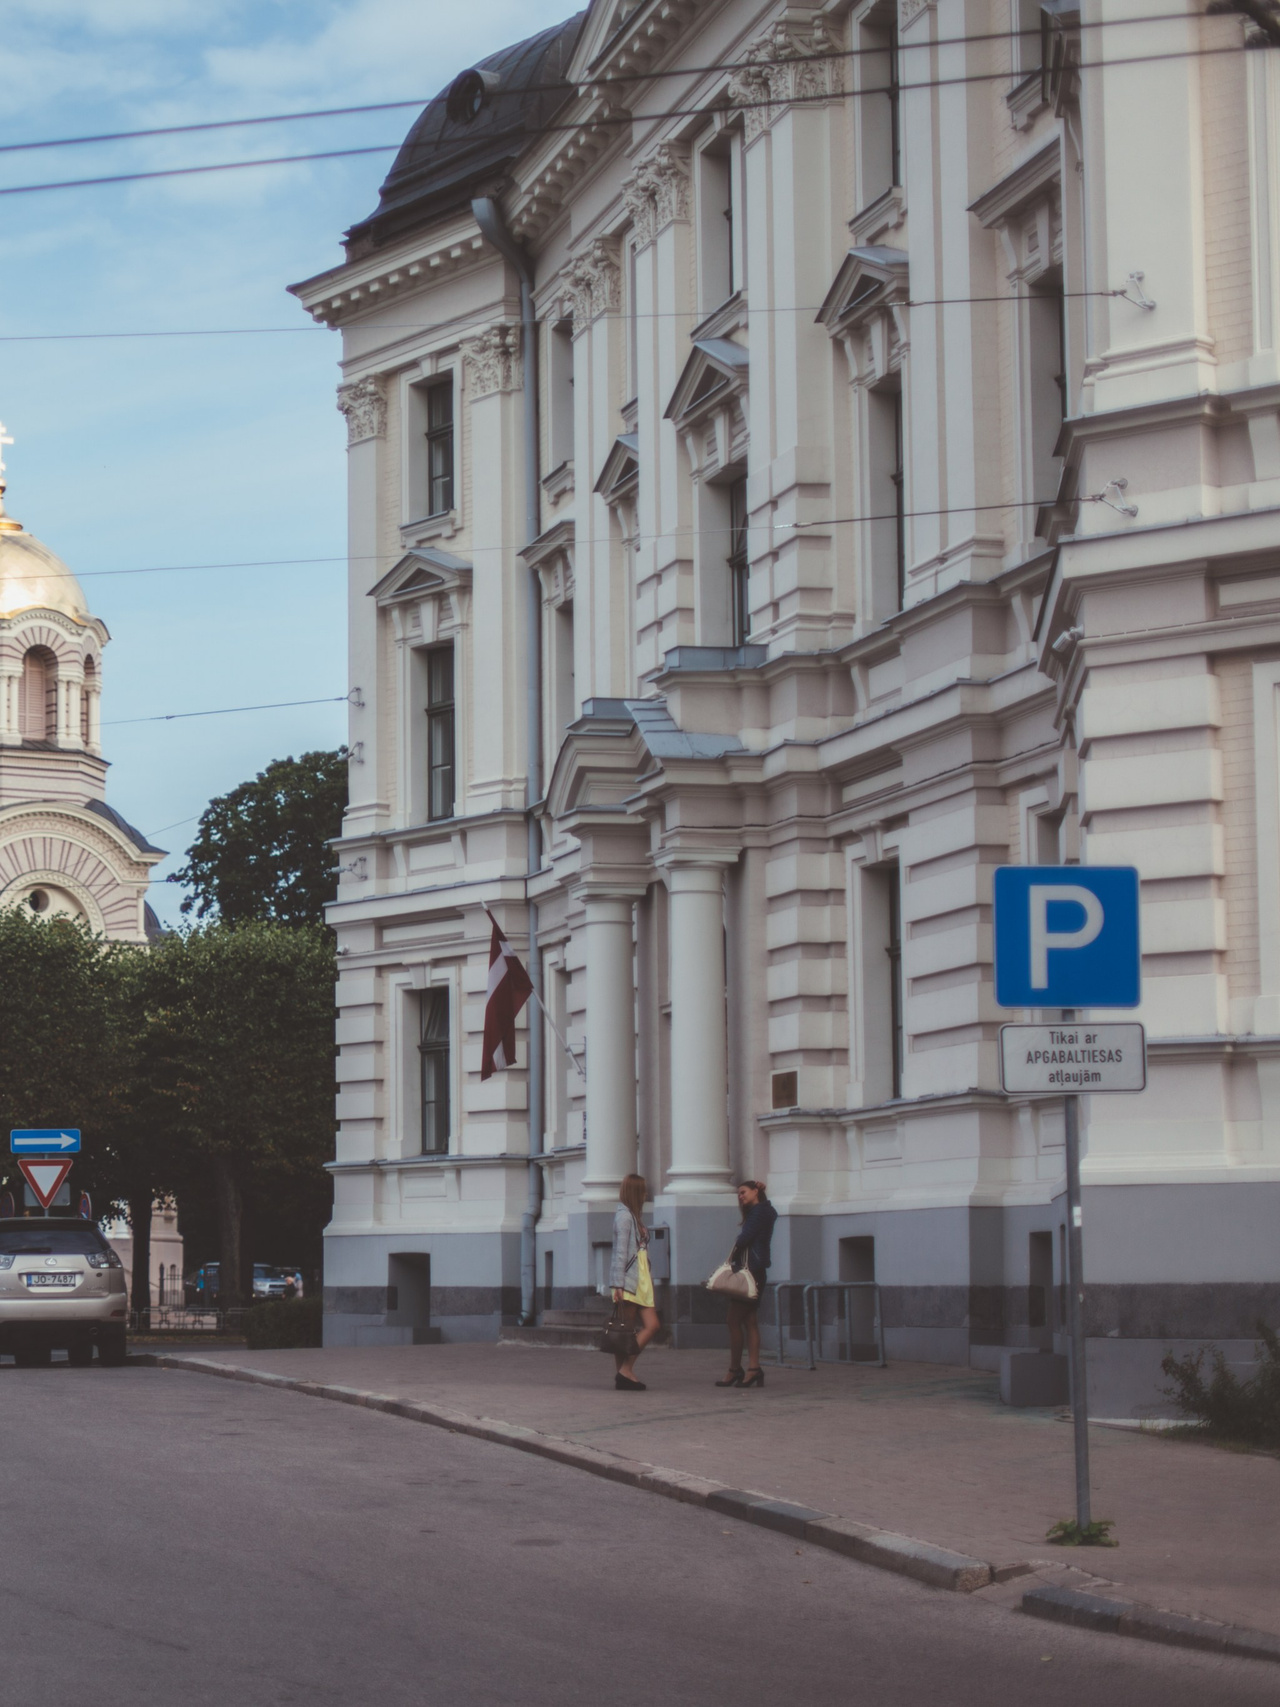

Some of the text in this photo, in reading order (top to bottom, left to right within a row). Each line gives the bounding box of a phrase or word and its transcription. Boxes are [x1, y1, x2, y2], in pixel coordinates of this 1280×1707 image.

[1028, 885, 1105, 989] P
[1049, 1031, 1097, 1044] Tikai ar
[1026, 1049, 1122, 1064] APGABALTIESAS
[1048, 1070, 1101, 1086] atļaujām
[33, 1275, 74, 1284] JO-7487
